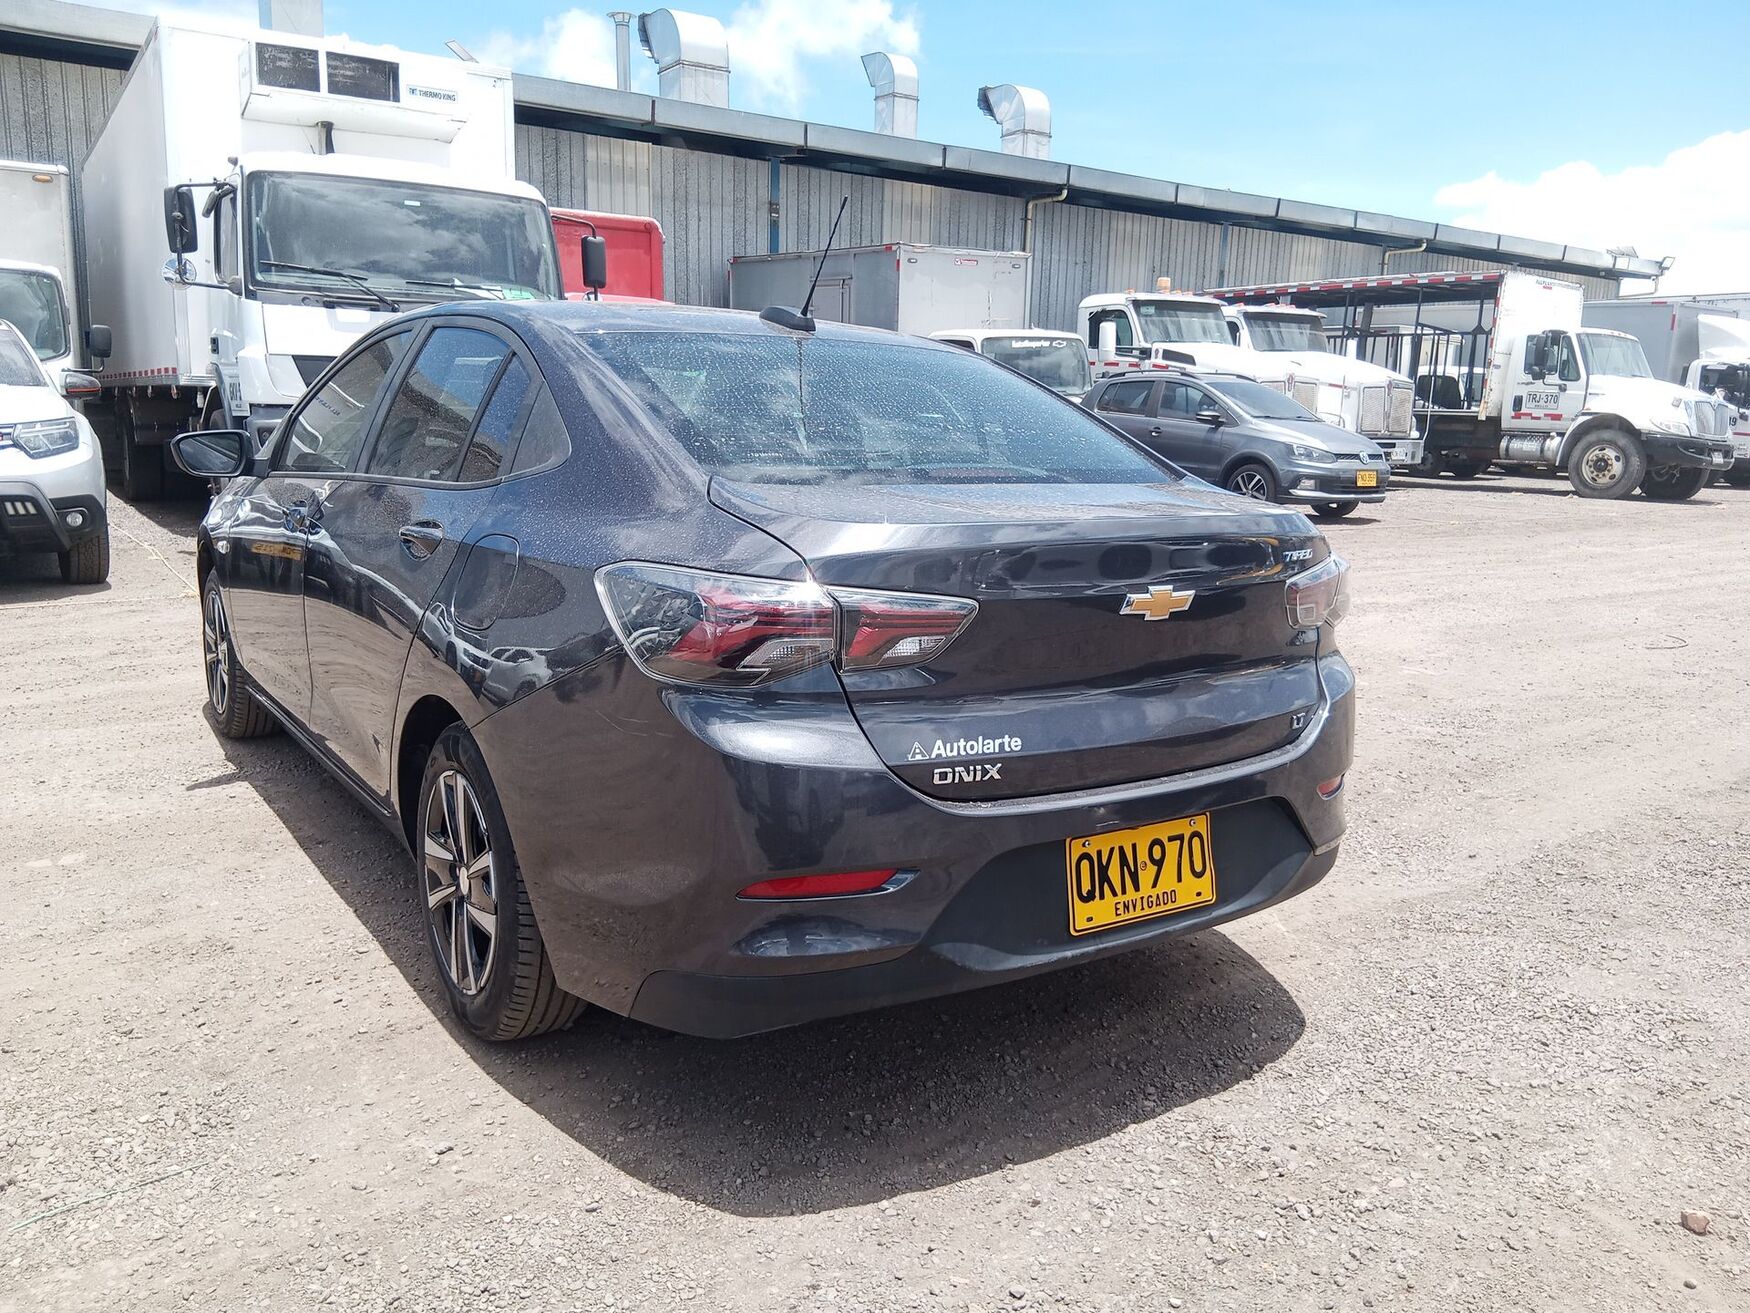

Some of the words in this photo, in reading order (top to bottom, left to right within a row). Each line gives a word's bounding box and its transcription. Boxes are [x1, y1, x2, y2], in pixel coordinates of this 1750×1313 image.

[419, 89, 442, 100] THERMO
[442, 93, 456, 101] KING
[1291, 712, 1306, 729] LT
[931, 735, 1022, 758] Autolarte
[1114, 889, 1178, 917] ENVIGADO
